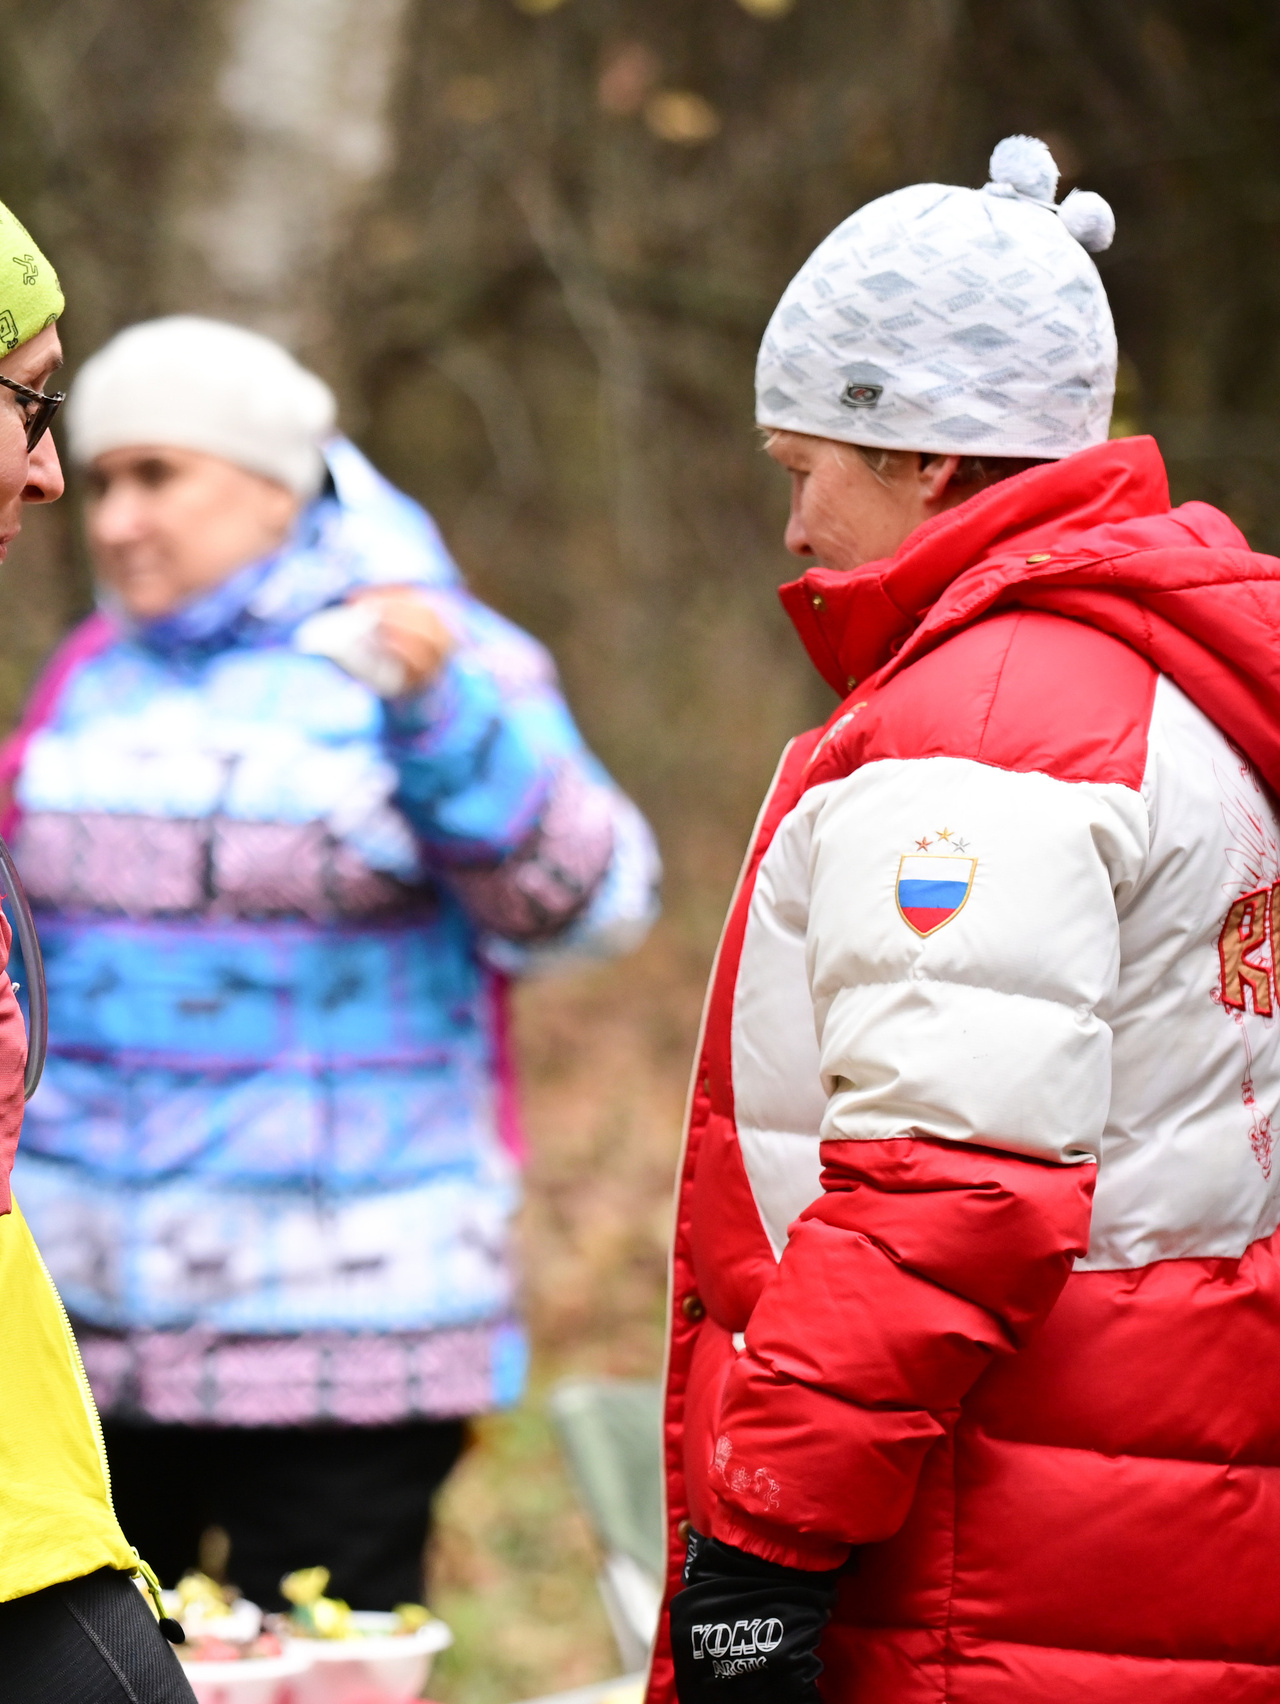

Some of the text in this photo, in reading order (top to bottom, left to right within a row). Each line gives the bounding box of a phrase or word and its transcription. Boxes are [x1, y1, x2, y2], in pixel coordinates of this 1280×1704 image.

[1218, 878, 1280, 1018] R
[691, 1617, 784, 1660] YOKO
[712, 1656, 769, 1677] ARCTIC
